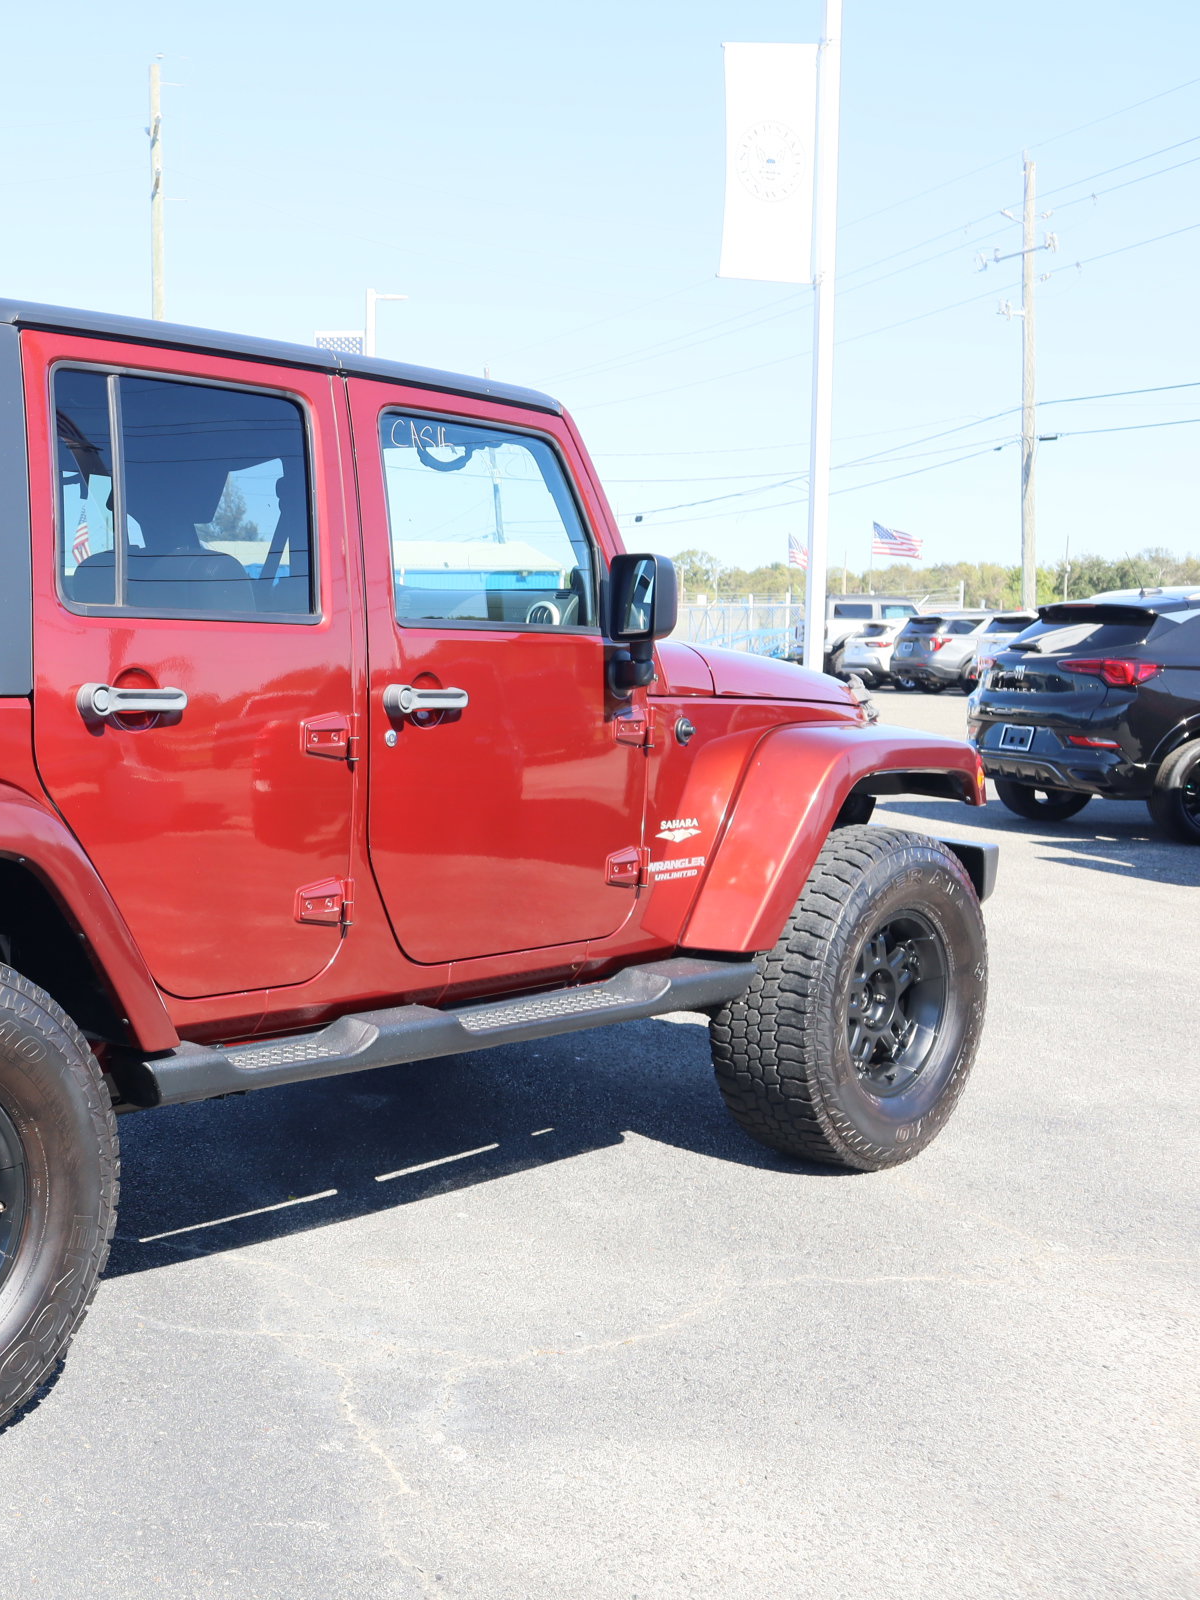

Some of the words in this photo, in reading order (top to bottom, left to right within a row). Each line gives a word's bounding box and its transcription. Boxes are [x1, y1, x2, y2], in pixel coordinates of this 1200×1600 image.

[660, 818, 699, 830] SAHARA
[648, 856, 705, 872] WRANGLER
[655, 869, 698, 881] UNLIMITED
